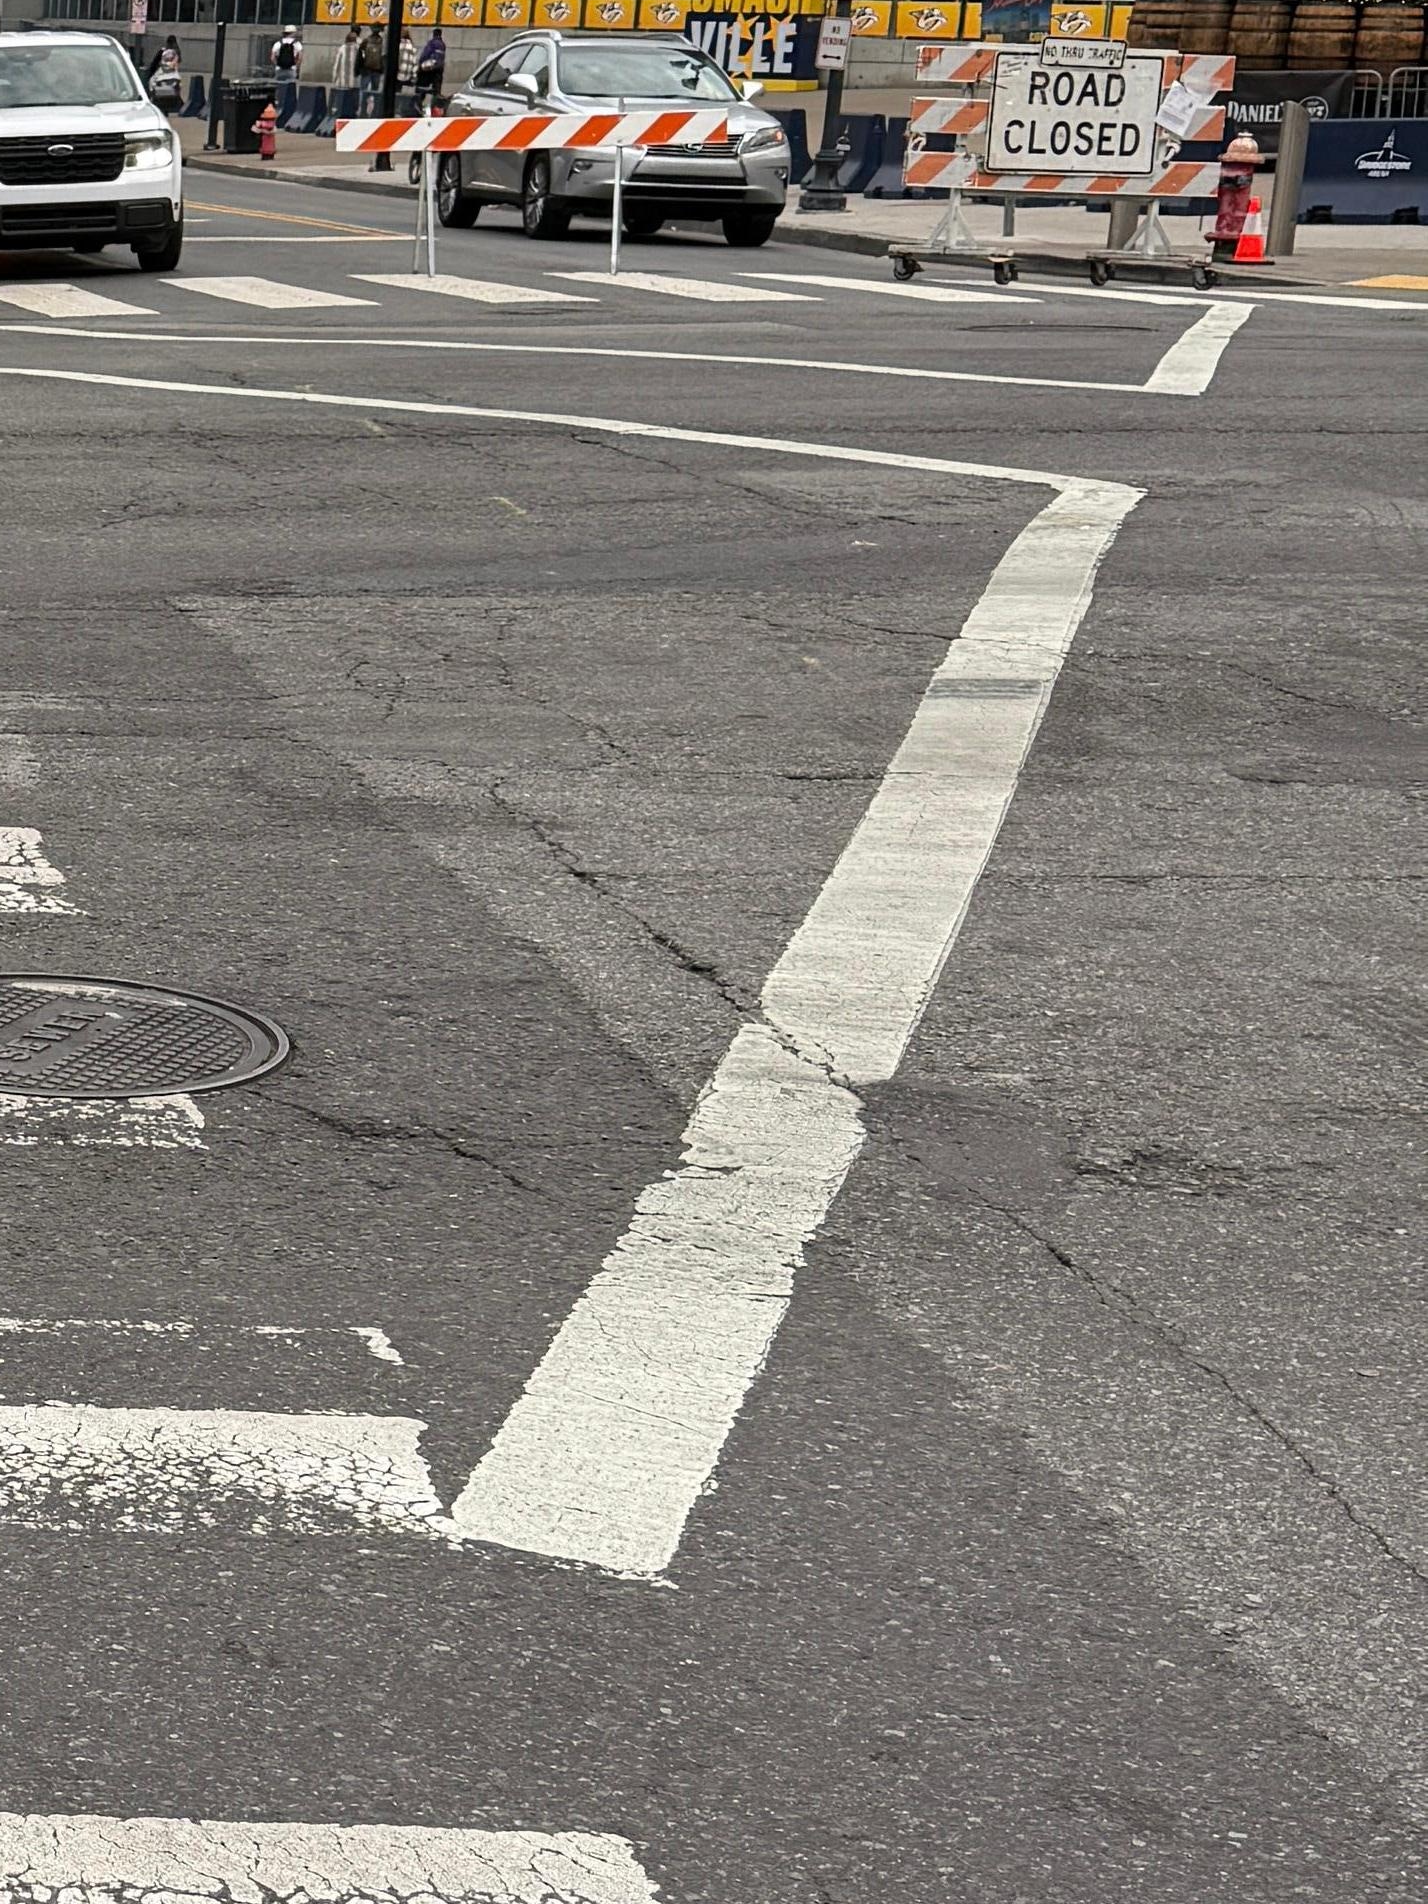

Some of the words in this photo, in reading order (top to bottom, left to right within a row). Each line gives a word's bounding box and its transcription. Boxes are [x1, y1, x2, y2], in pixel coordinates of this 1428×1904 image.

[690, 20, 797, 74] VILLE
[1045, 46, 1058, 57] NO
[1062, 46, 1085, 58] THRU
[1089, 47, 1123, 61] TRAFFIC
[1028, 71, 1126, 108] ROAD
[1003, 119, 1141, 157] CLOSED
